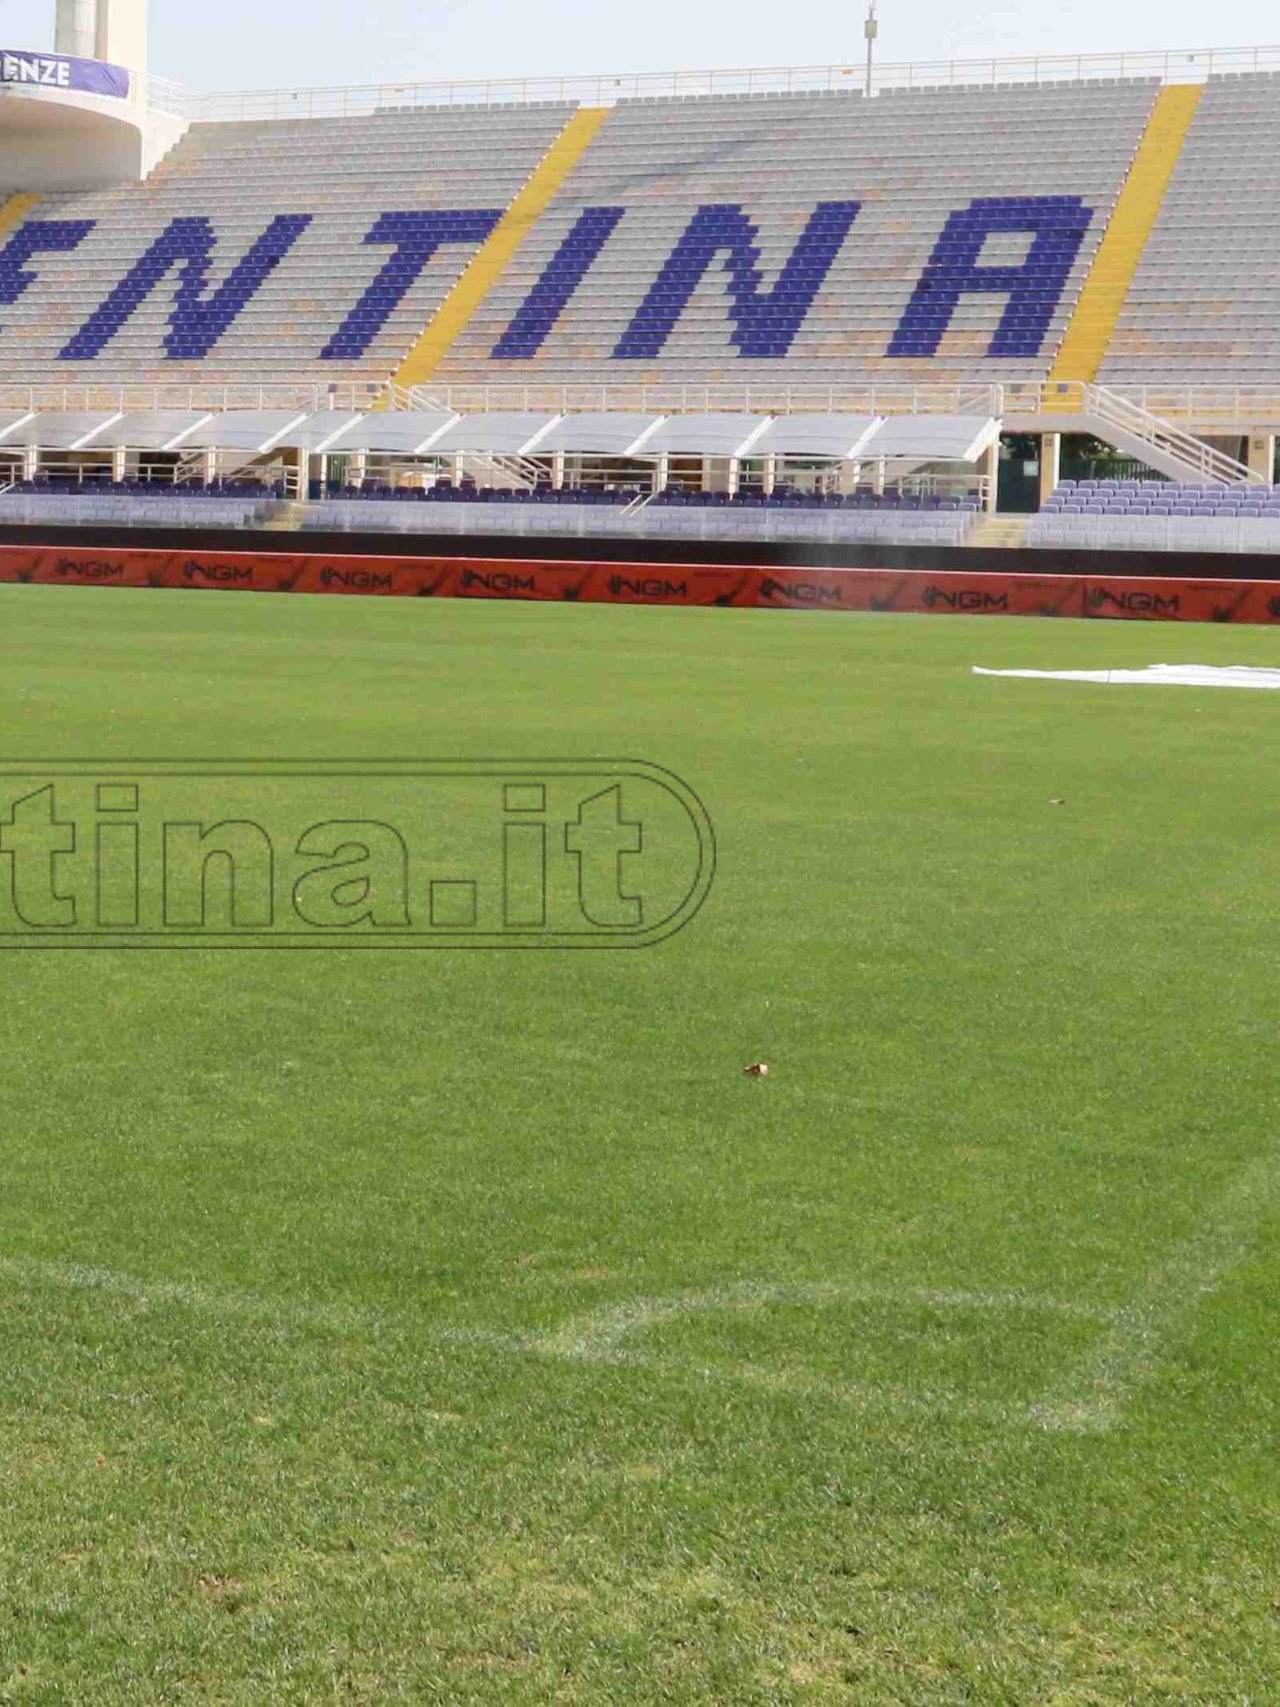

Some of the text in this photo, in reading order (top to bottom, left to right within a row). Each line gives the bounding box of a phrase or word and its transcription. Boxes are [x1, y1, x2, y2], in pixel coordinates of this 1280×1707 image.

[60, 558, 124, 577] NGM
[188, 560, 254, 581] NGM
[325, 568, 393, 588] NGM
[467, 571, 536, 591] NGM
[615, 575, 687, 597] NGM
[766, 580, 842, 602] NGM
[929, 587, 1008, 609] NGM
[1097, 588, 1180, 612] NGM
